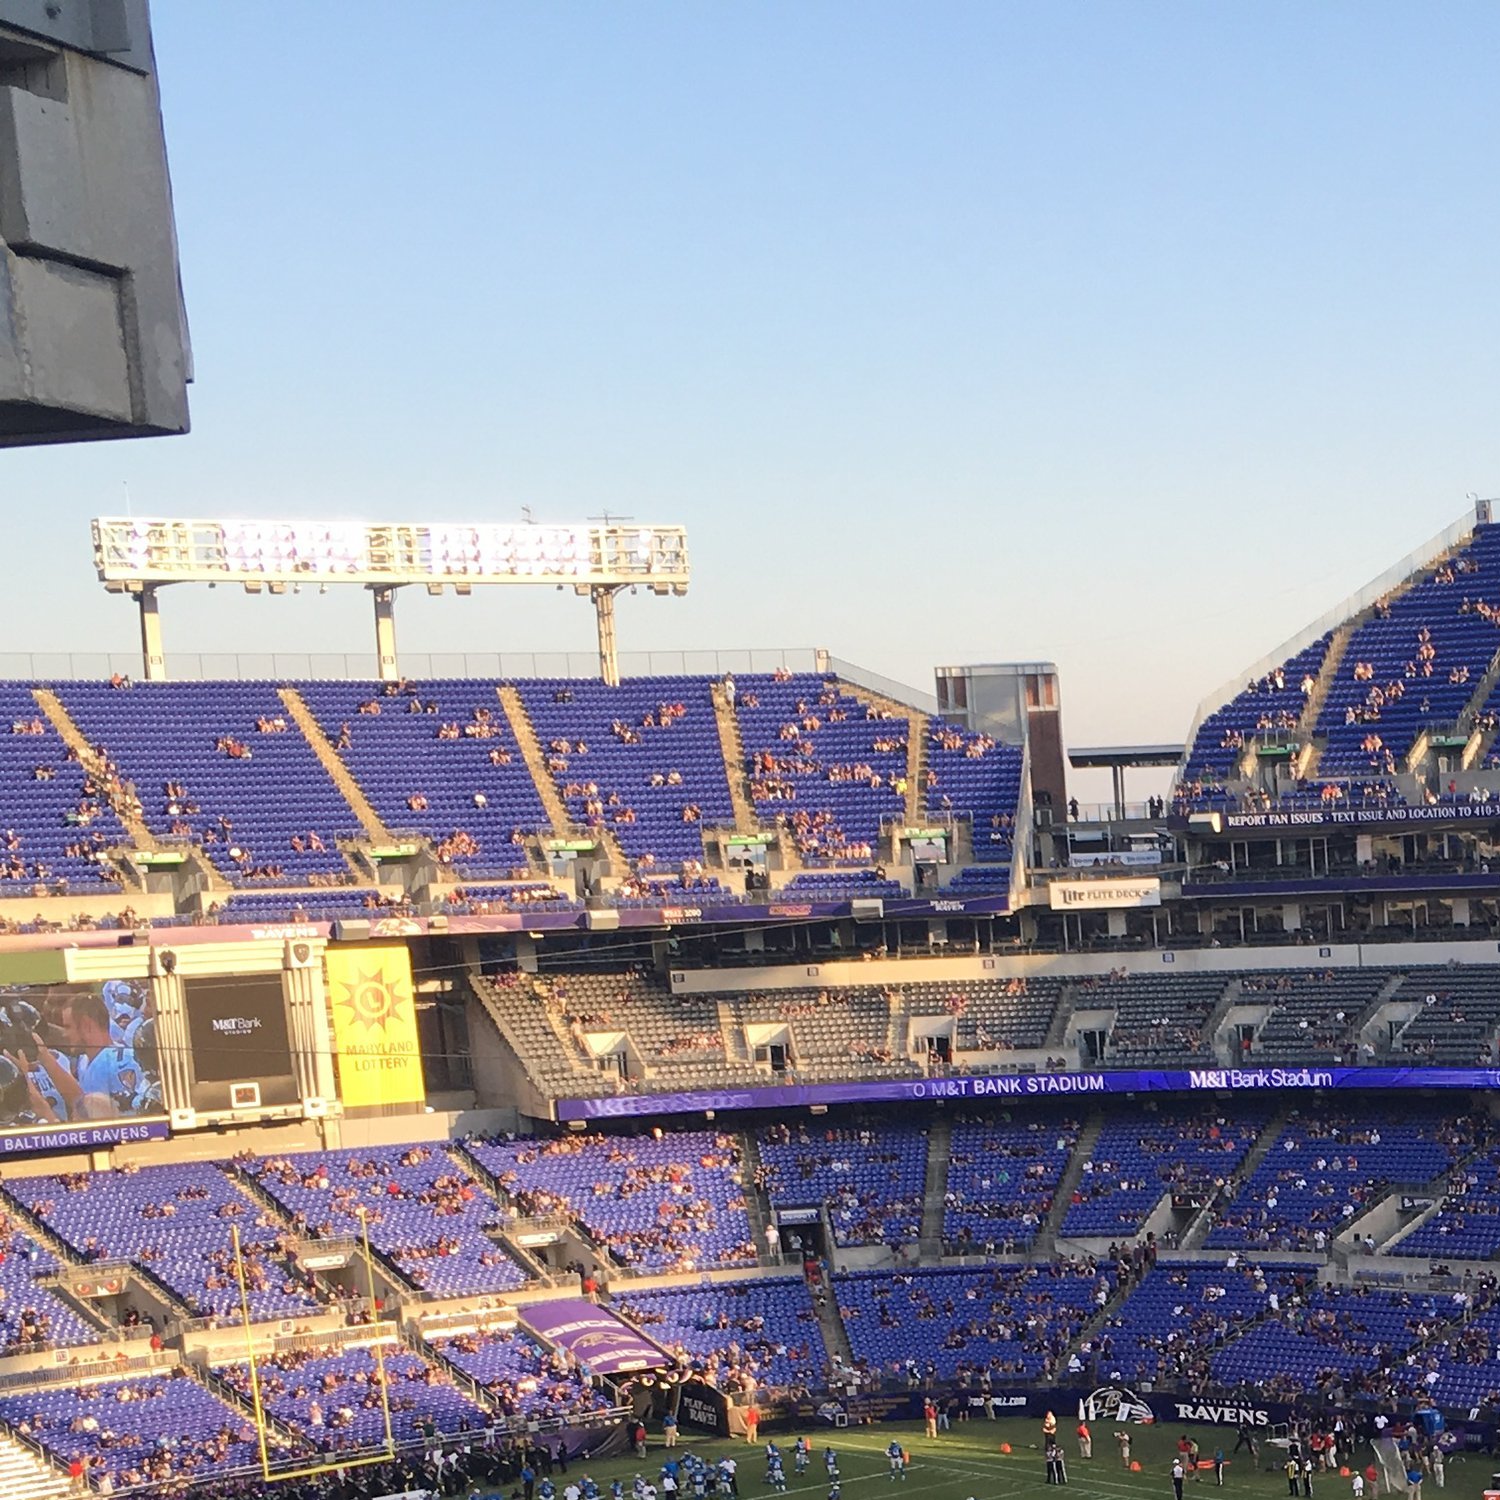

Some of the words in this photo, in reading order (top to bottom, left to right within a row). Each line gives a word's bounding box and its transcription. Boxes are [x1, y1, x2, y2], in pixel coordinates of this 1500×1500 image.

[1228, 813, 1266, 827] REPORT
[1269, 813, 1289, 825] FAN
[1290, 812, 1323, 825] ISSUES
[1332, 811, 1355, 823] TEXT
[1358, 810, 1384, 822] ISSUE
[1386, 809, 1407, 820] AND
[1409, 807, 1456, 820] LOCATION
[1458, 806, 1471, 818] TO
[354, 1057, 410, 1072] LOTTERY
[931, 1080, 968, 1096] M&T
[974, 1078, 1023, 1095] BANK
[1027, 1075, 1104, 1093] STADIUM
[1270, 1068, 1334, 1088] Stadium
[4, 1129, 88, 1151] BALTIMORE
[93, 1125, 149, 1143] RAVENS
[541, 1320, 625, 1338] GEICO
[1176, 1403, 1270, 1426] RAVENS
